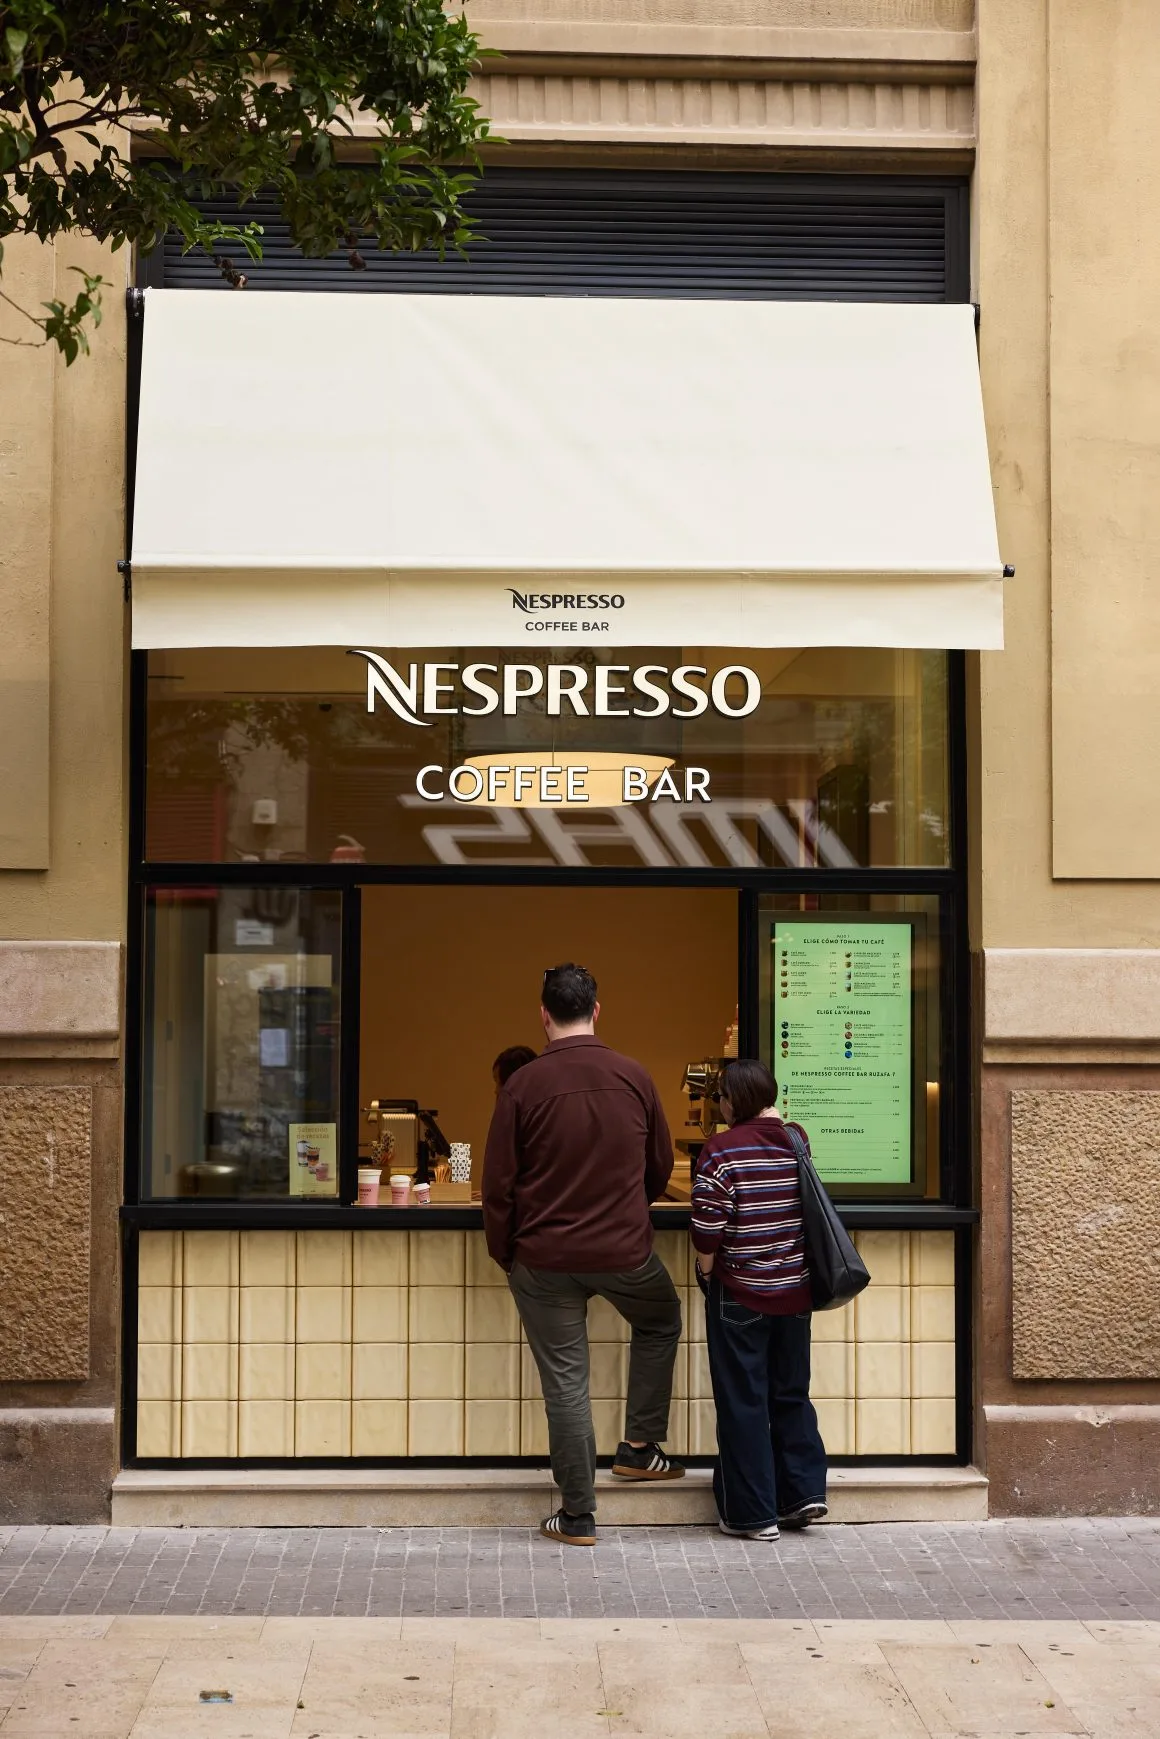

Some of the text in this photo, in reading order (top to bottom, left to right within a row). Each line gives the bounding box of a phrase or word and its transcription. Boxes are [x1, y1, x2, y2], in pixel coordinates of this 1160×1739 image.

[503, 587, 625, 614] NESPRESSO
[525, 621, 610, 632] COFFEE BAR
[346, 650, 762, 726] NESPRESSO
[416, 764, 712, 803] COFFEE BAR
[821, 937, 839, 945] CÓMO
